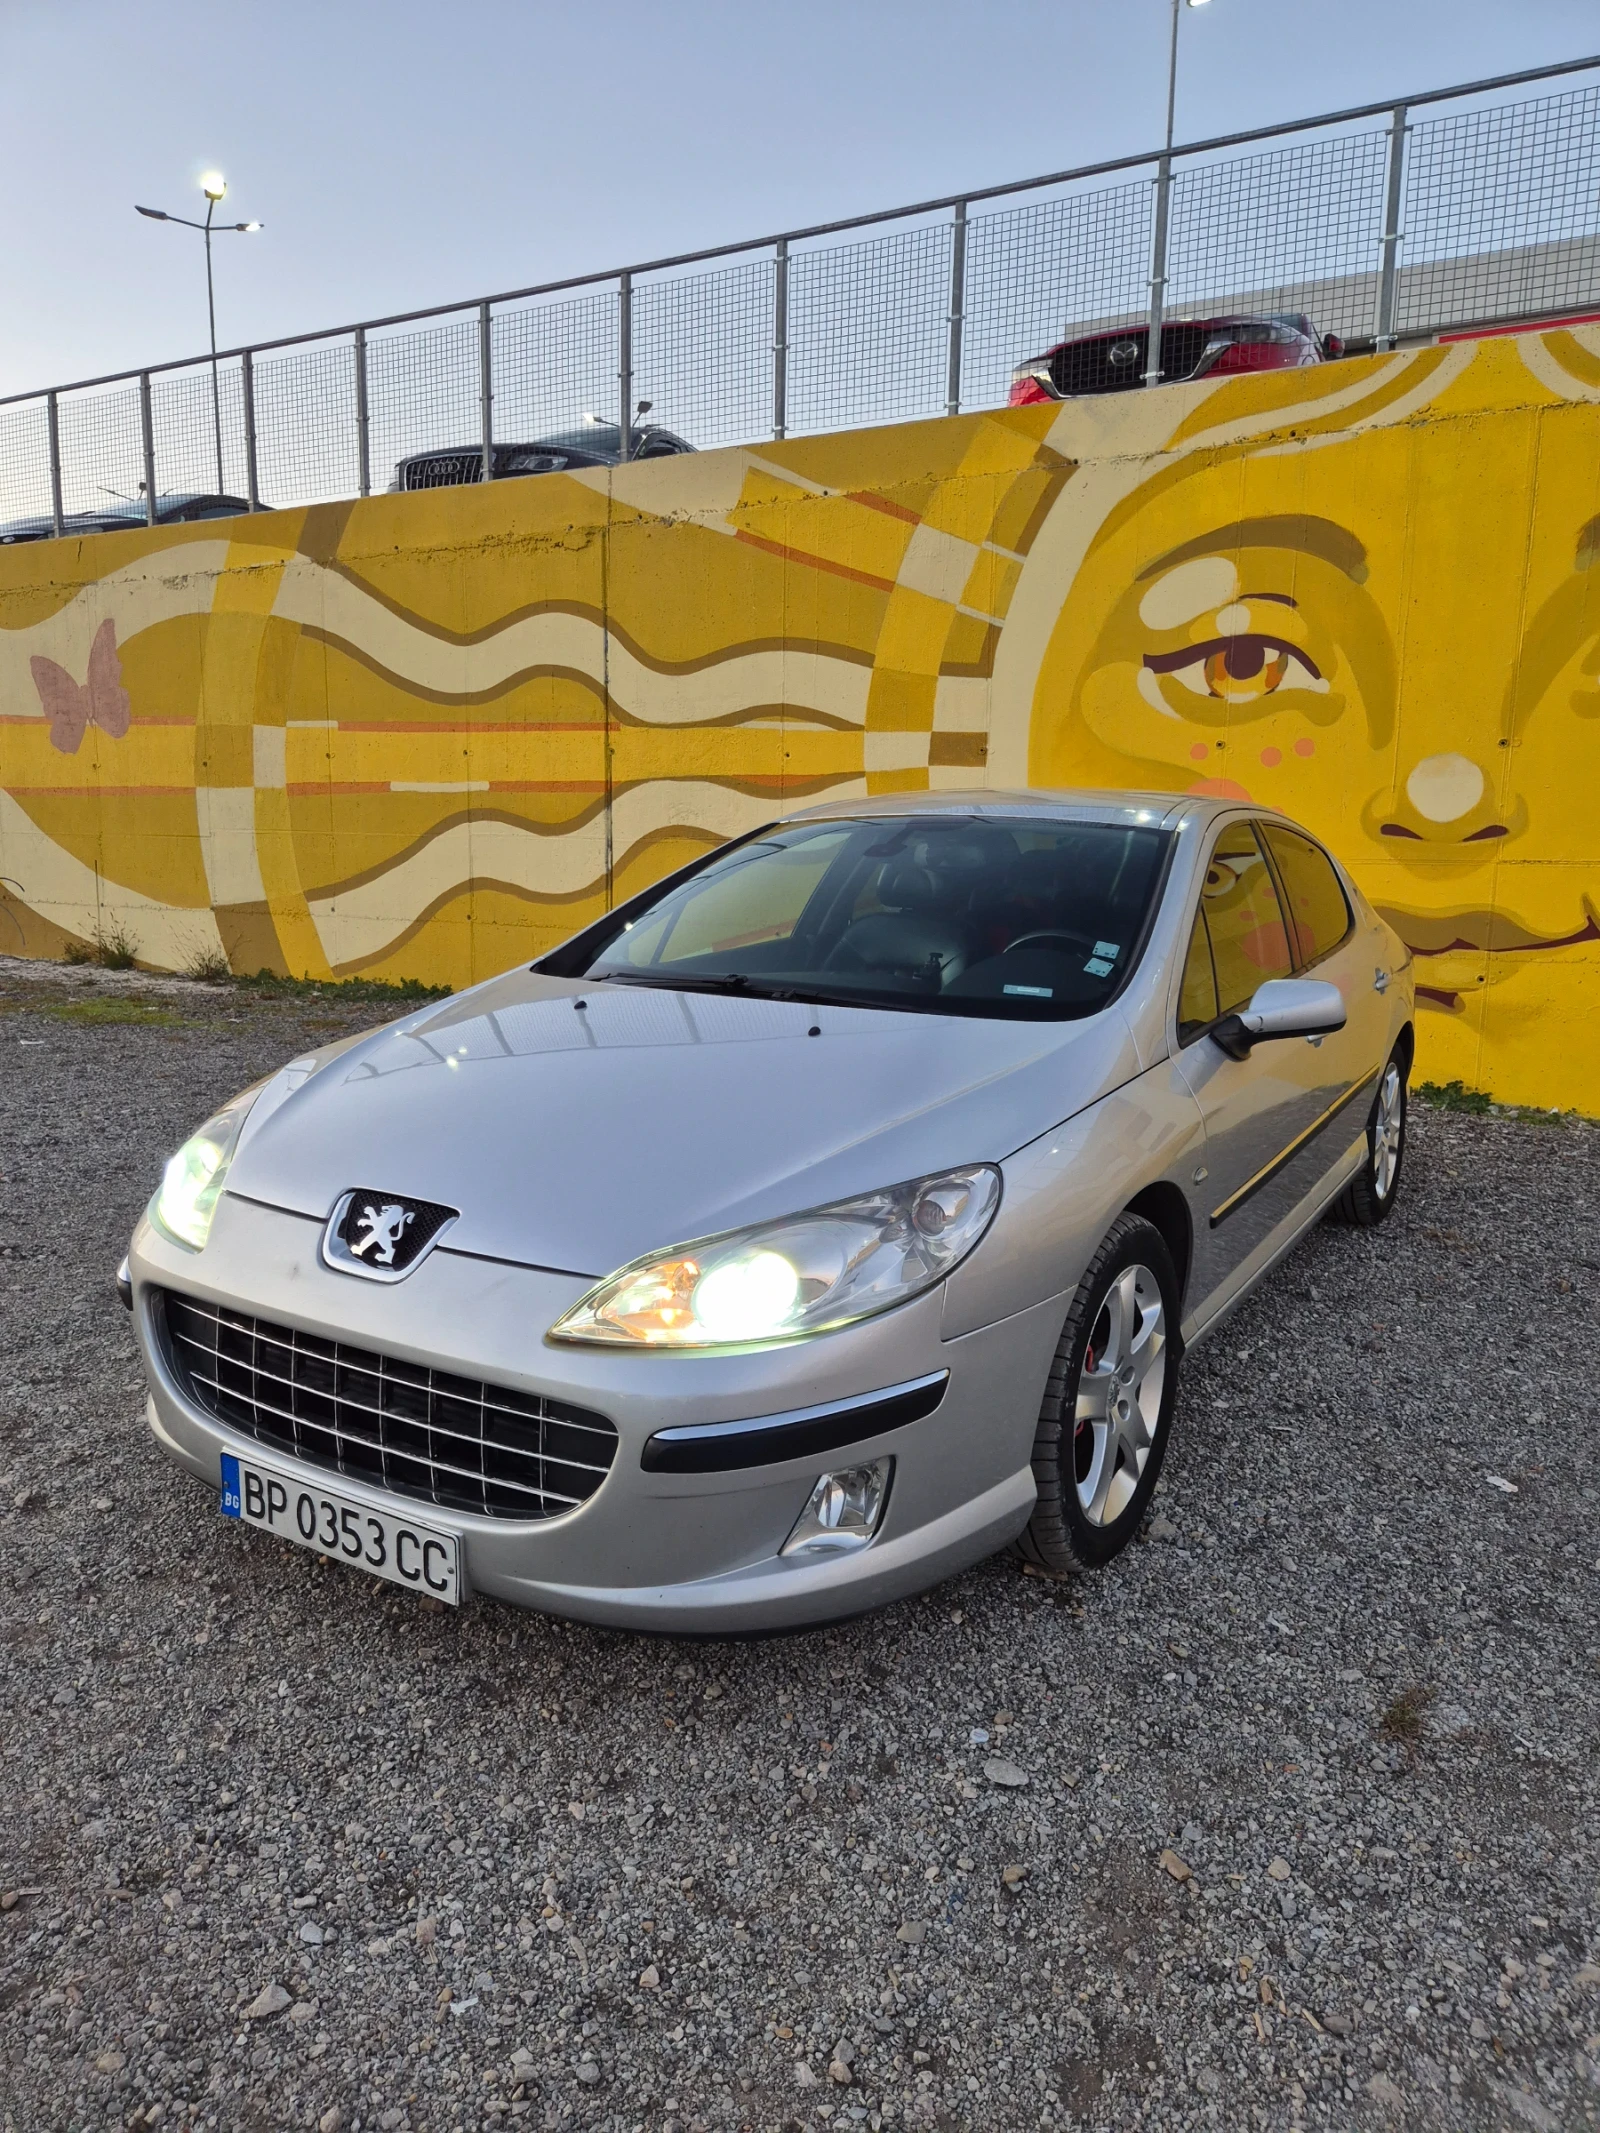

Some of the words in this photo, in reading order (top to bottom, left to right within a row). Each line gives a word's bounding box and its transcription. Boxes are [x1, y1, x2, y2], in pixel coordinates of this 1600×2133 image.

[225, 1491, 240, 1509] BG
[244, 1470, 287, 1525] BP
[296, 1492, 386, 1567] 0353
[396, 1529, 448, 1592] CC
